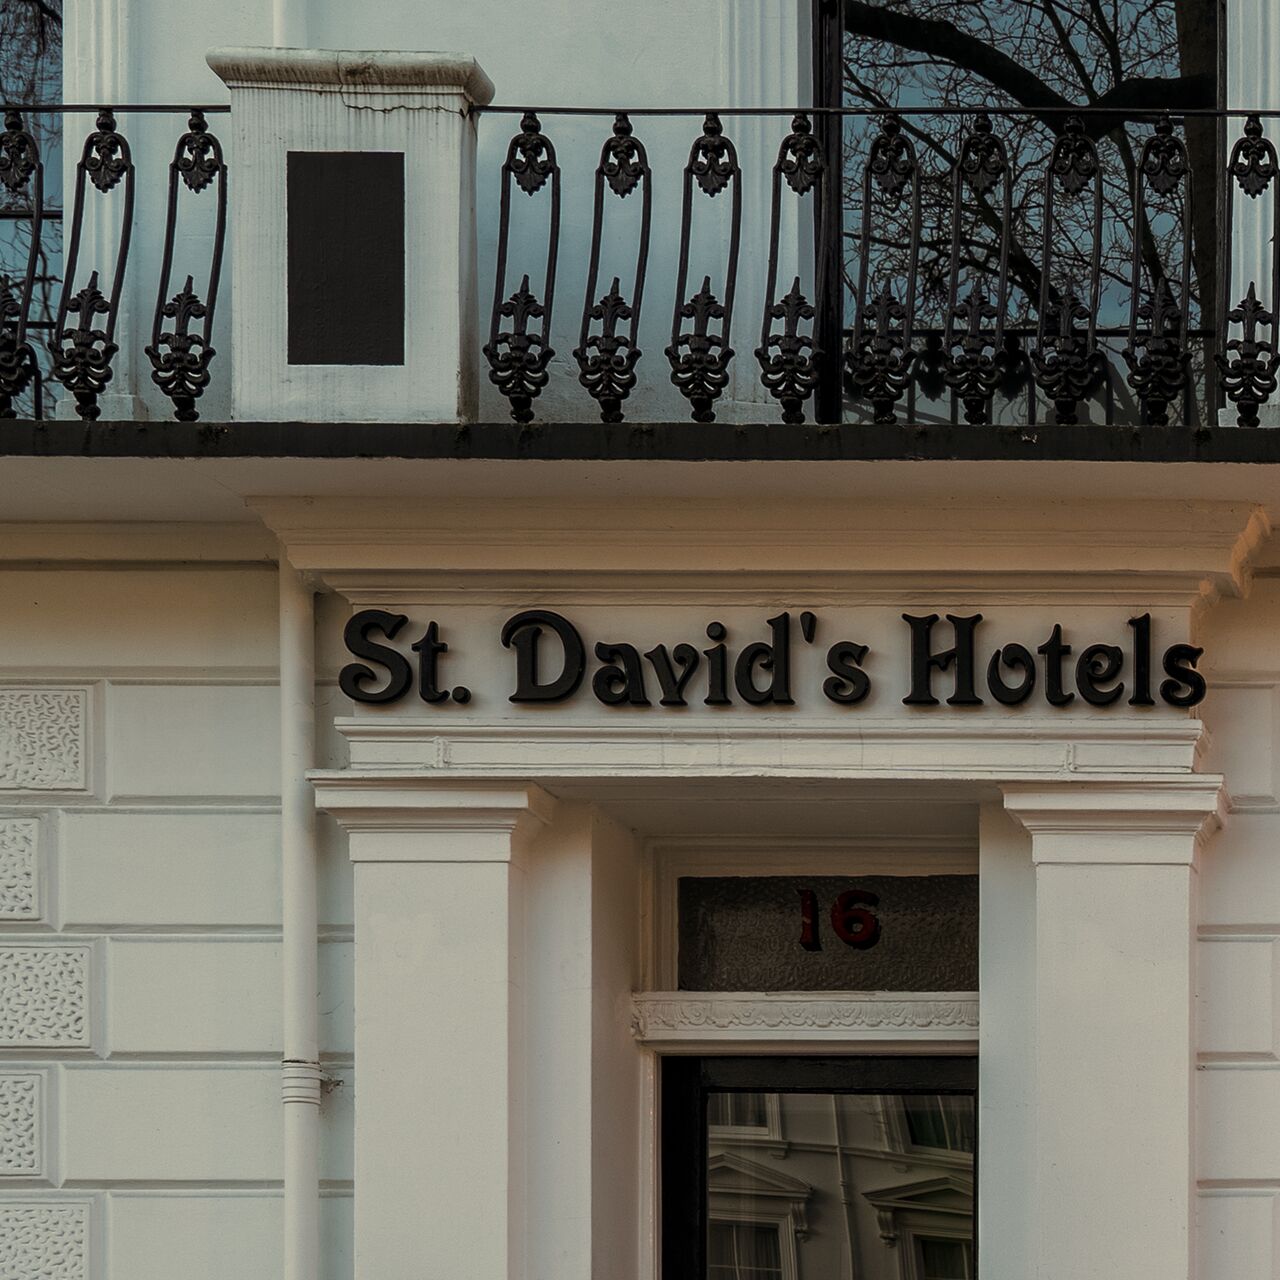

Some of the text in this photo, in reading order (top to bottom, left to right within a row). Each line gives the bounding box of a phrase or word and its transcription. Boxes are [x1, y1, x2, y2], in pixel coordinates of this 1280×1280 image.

[338, 609, 1209, 707] St. David's Hotels
[797, 888, 882, 951] 16
